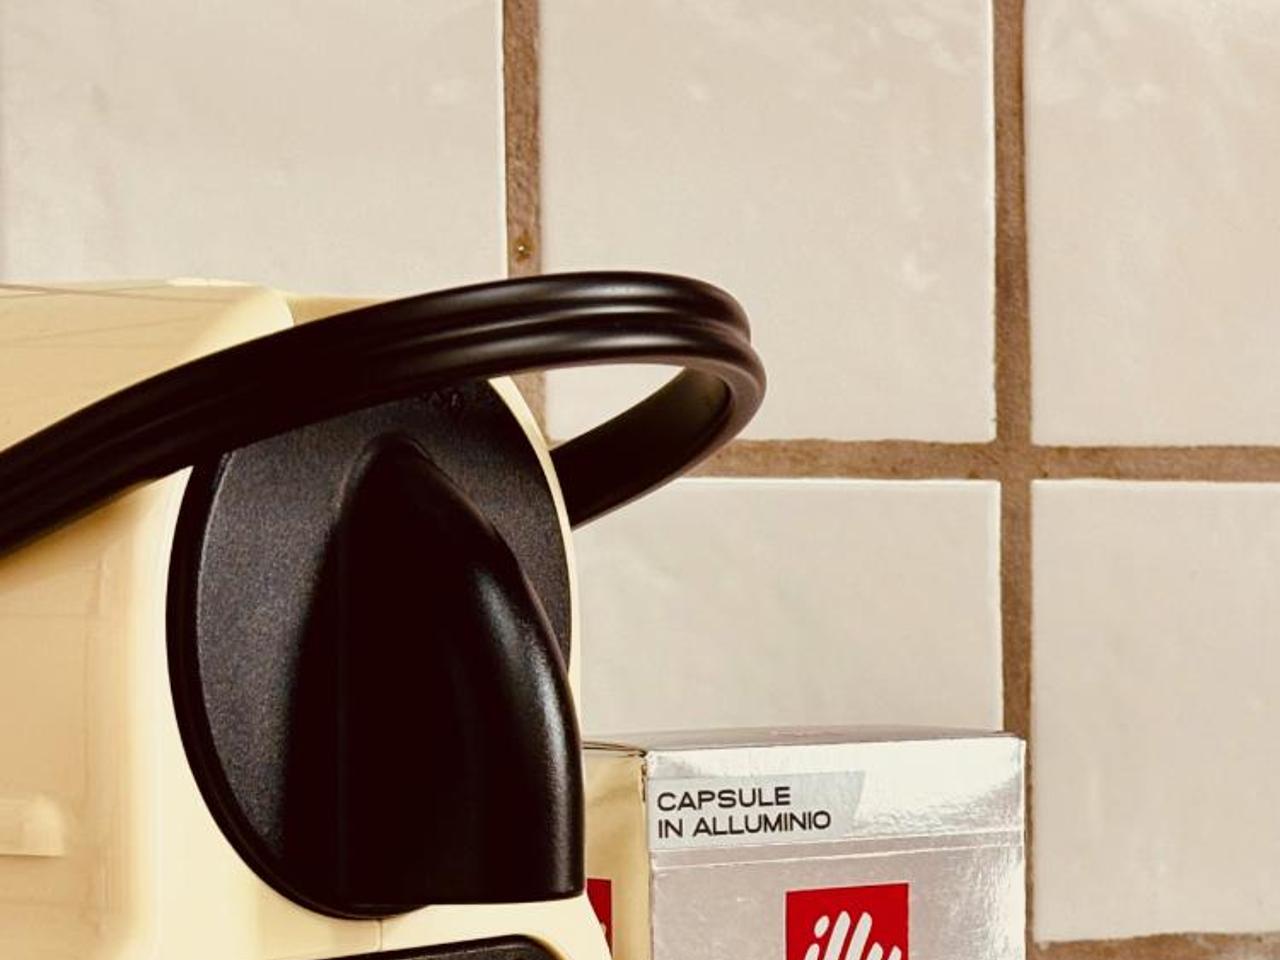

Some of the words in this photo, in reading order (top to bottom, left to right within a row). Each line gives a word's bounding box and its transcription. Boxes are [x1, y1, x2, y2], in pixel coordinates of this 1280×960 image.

[657, 786, 791, 811] CAPSULE
[657, 819, 684, 838] IN
[692, 810, 831, 837] ALLUMINIO
